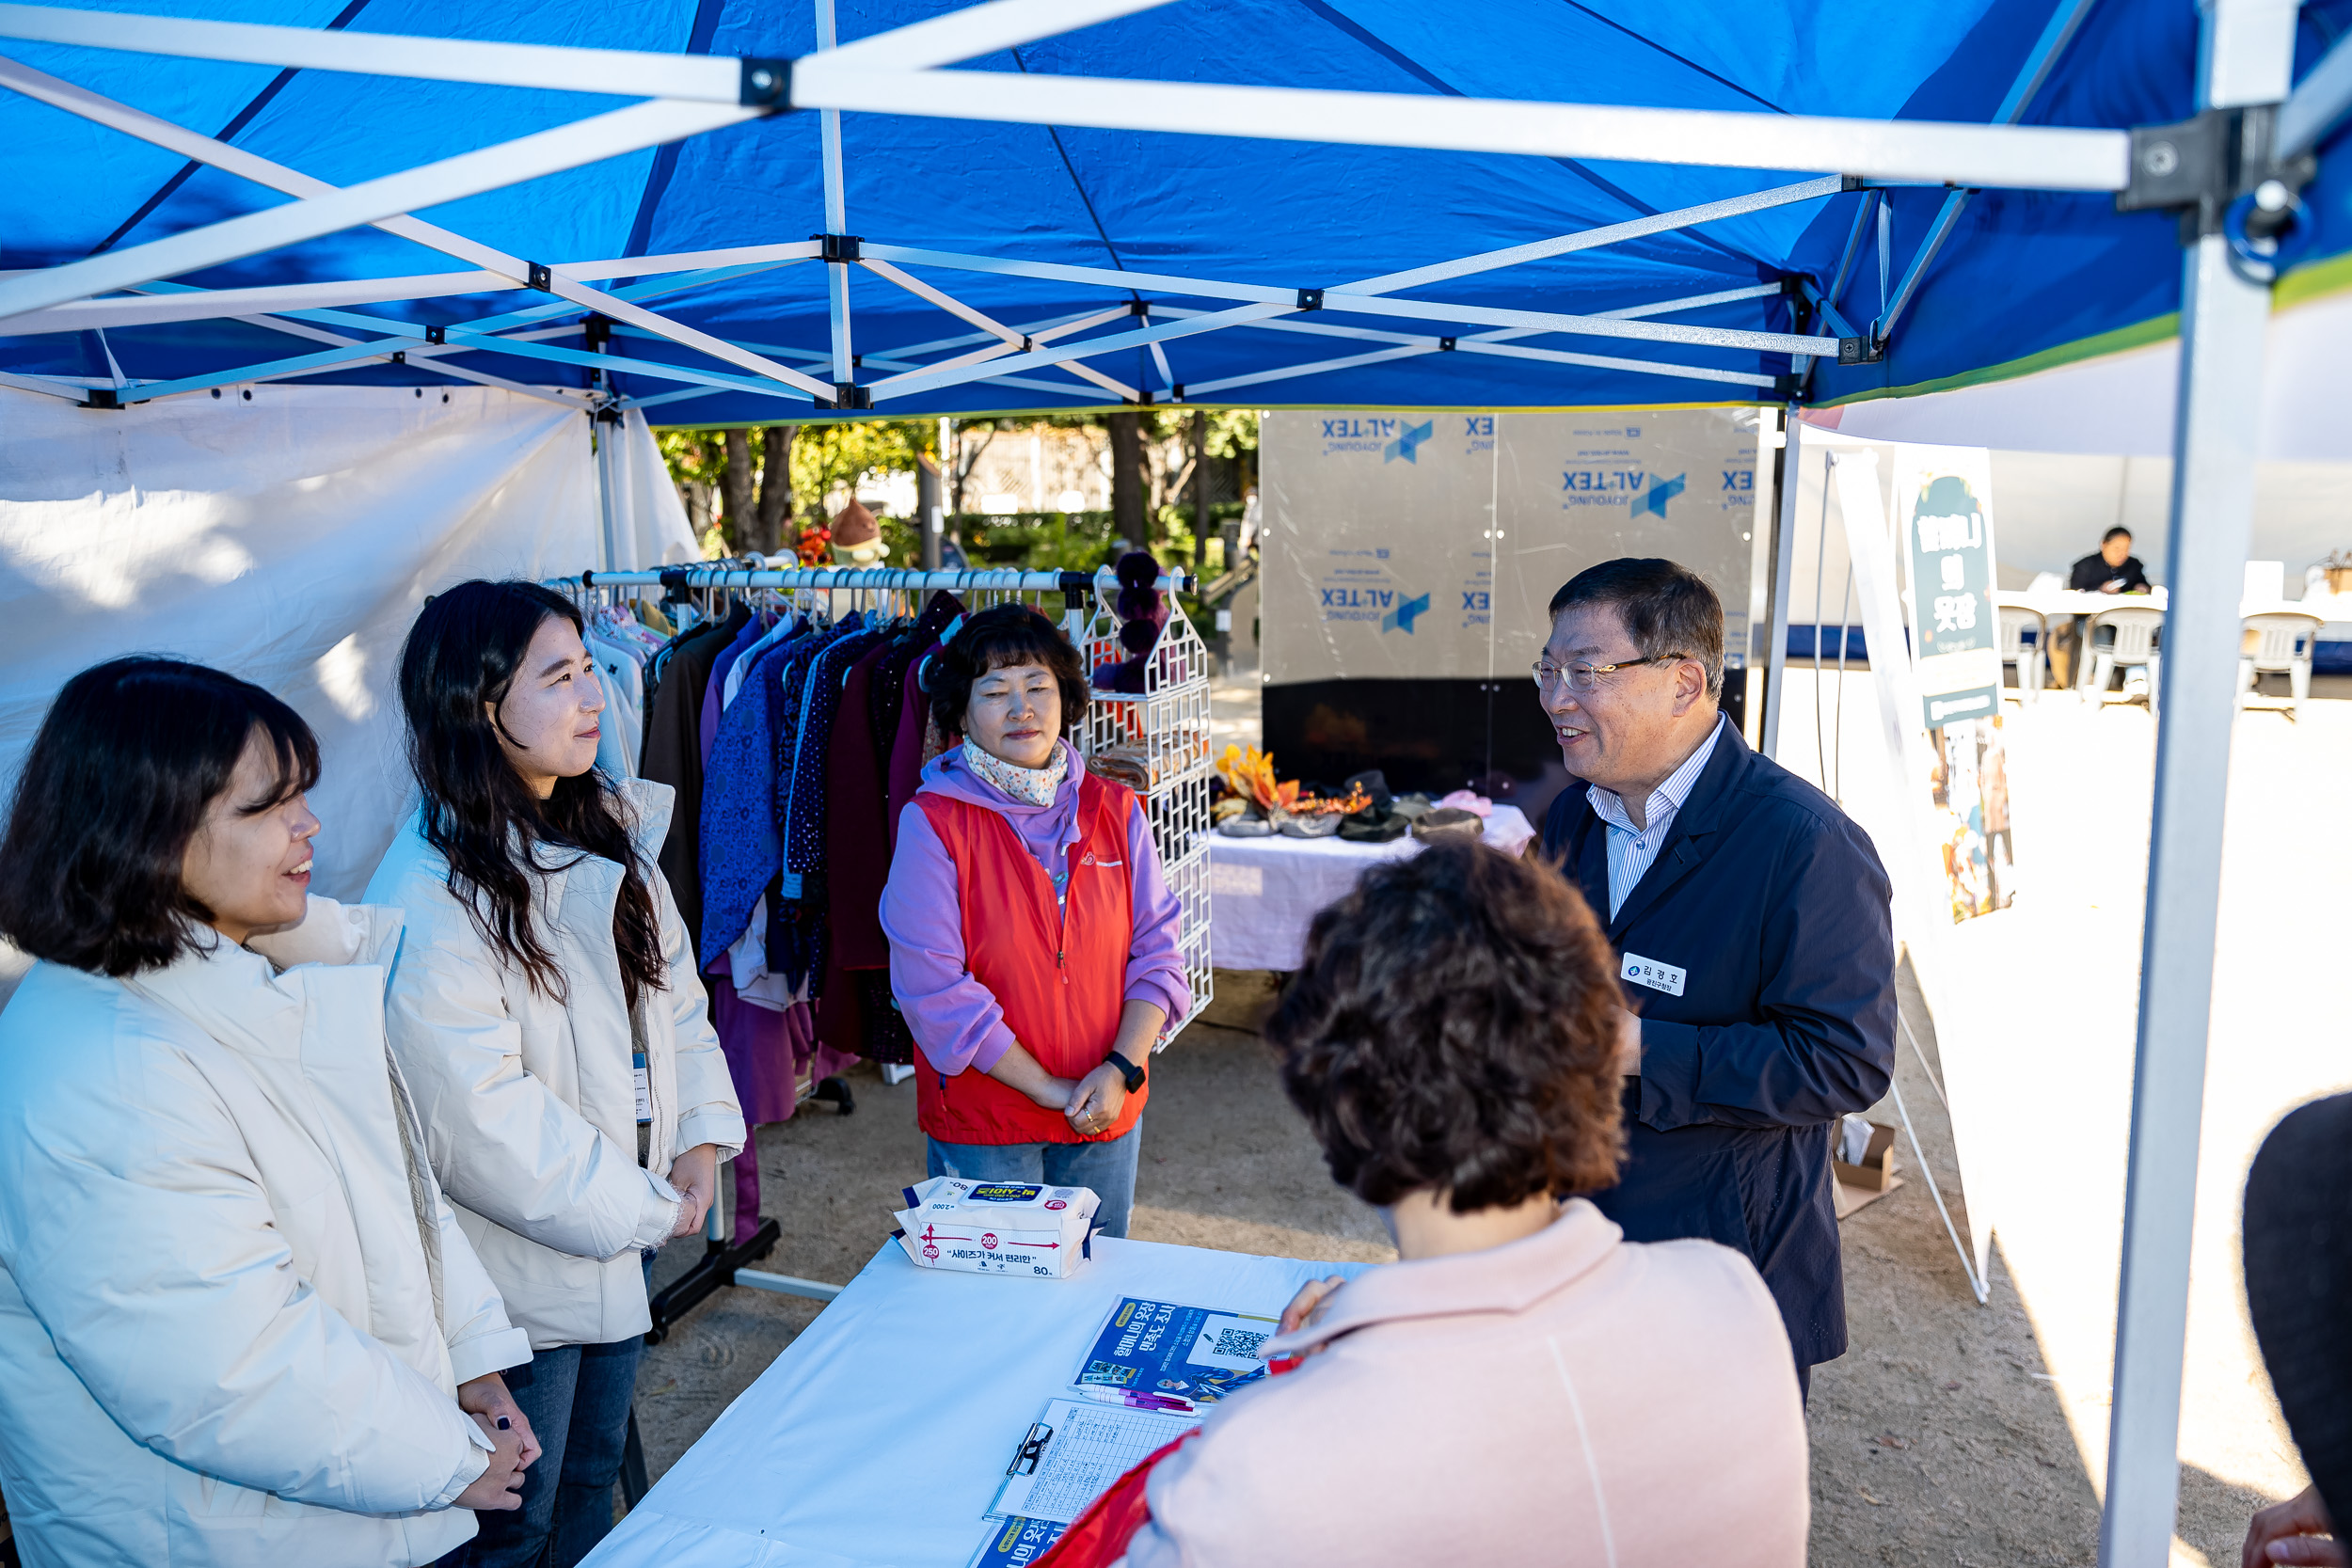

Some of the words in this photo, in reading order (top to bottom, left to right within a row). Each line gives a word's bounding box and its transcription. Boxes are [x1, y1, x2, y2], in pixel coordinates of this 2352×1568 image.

[982, 1235, 997, 1244] 200
[924, 1247, 938, 1256] 250
[987, 1251, 1003, 1261] 커서
[1113, 1321, 1147, 1357] 할머니의
[1134, 1301, 1156, 1322] 옷장
[1138, 1324, 1166, 1352] 만족도
[1153, 1305, 1176, 1324] 조사
